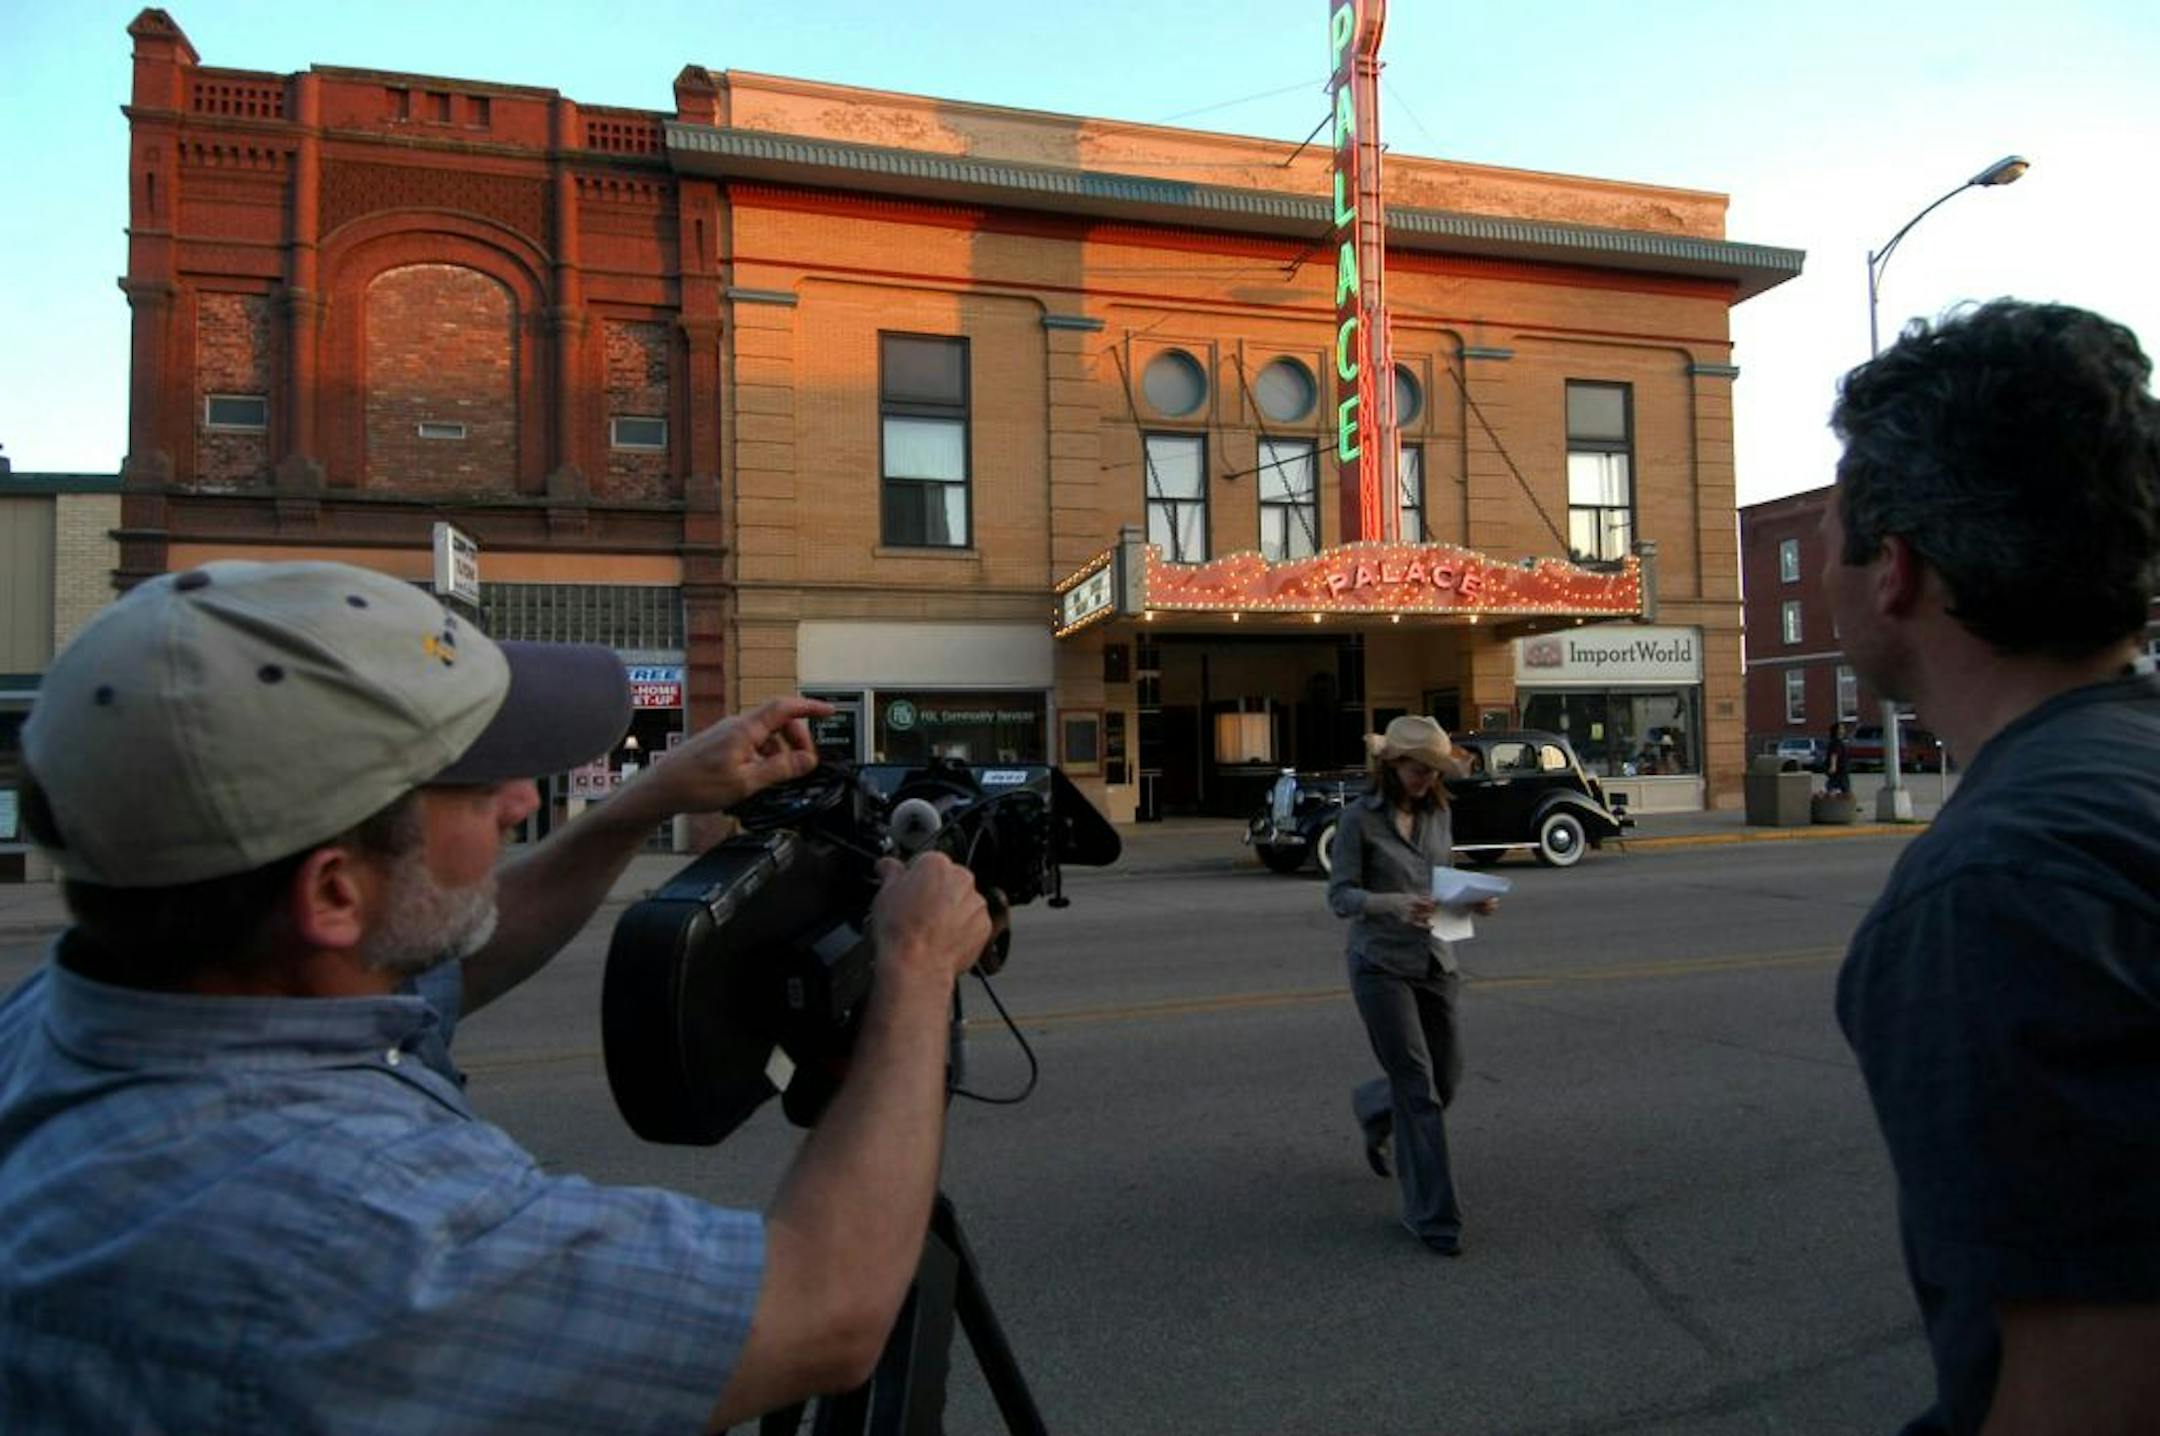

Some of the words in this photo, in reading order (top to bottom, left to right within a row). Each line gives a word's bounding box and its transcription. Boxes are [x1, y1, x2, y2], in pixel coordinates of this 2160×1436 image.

[1331, 2, 1360, 463] PALACE
[1326, 560, 1482, 599] PALACE
[1569, 639, 1692, 666] ImportWorld
